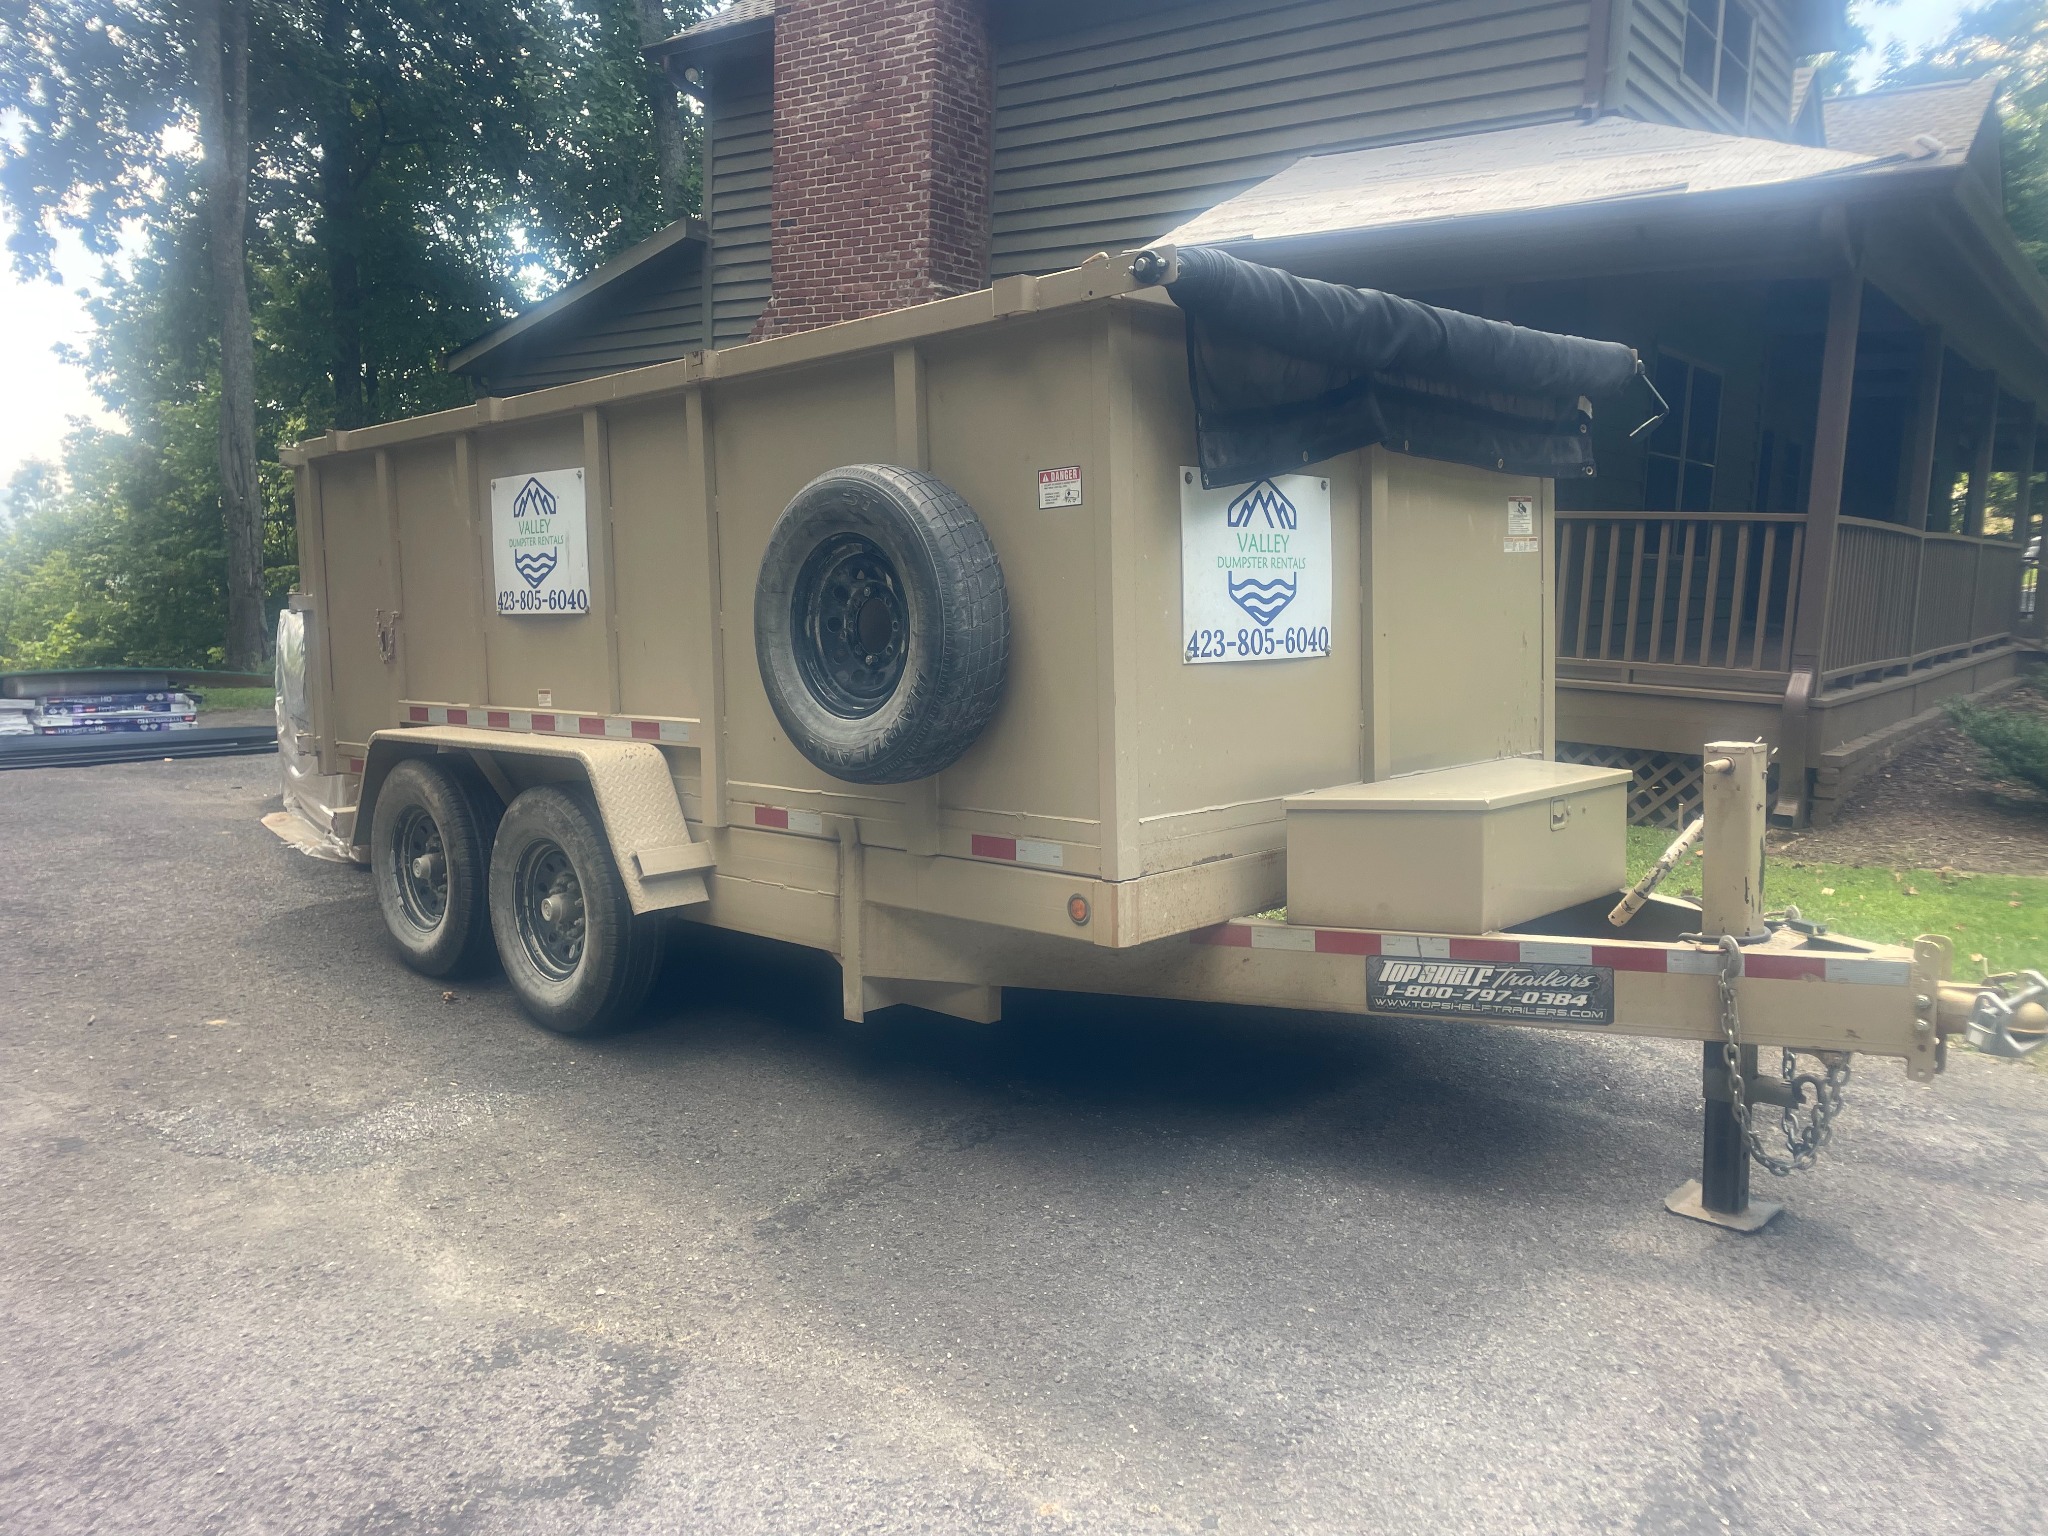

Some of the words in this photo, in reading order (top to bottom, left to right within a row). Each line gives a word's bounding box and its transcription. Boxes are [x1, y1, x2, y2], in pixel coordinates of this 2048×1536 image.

[1050, 468, 1078, 482] DANGER
[518, 518, 551, 535] VALLEY
[508, 536, 537, 548] DUMPSTER
[537, 535, 564, 545] RENTALS
[1236, 532, 1290, 553] VALLEY
[1217, 556, 1269, 569] DUMPSTER
[1270, 557, 1307, 570] RENTALS
[498, 588, 588, 611] 423-805-6040
[1187, 626, 1329, 658] 423-805-6040
[1492, 966, 1595, 990] Trailers
[1385, 984, 1589, 1007] 1-800-797-0384
